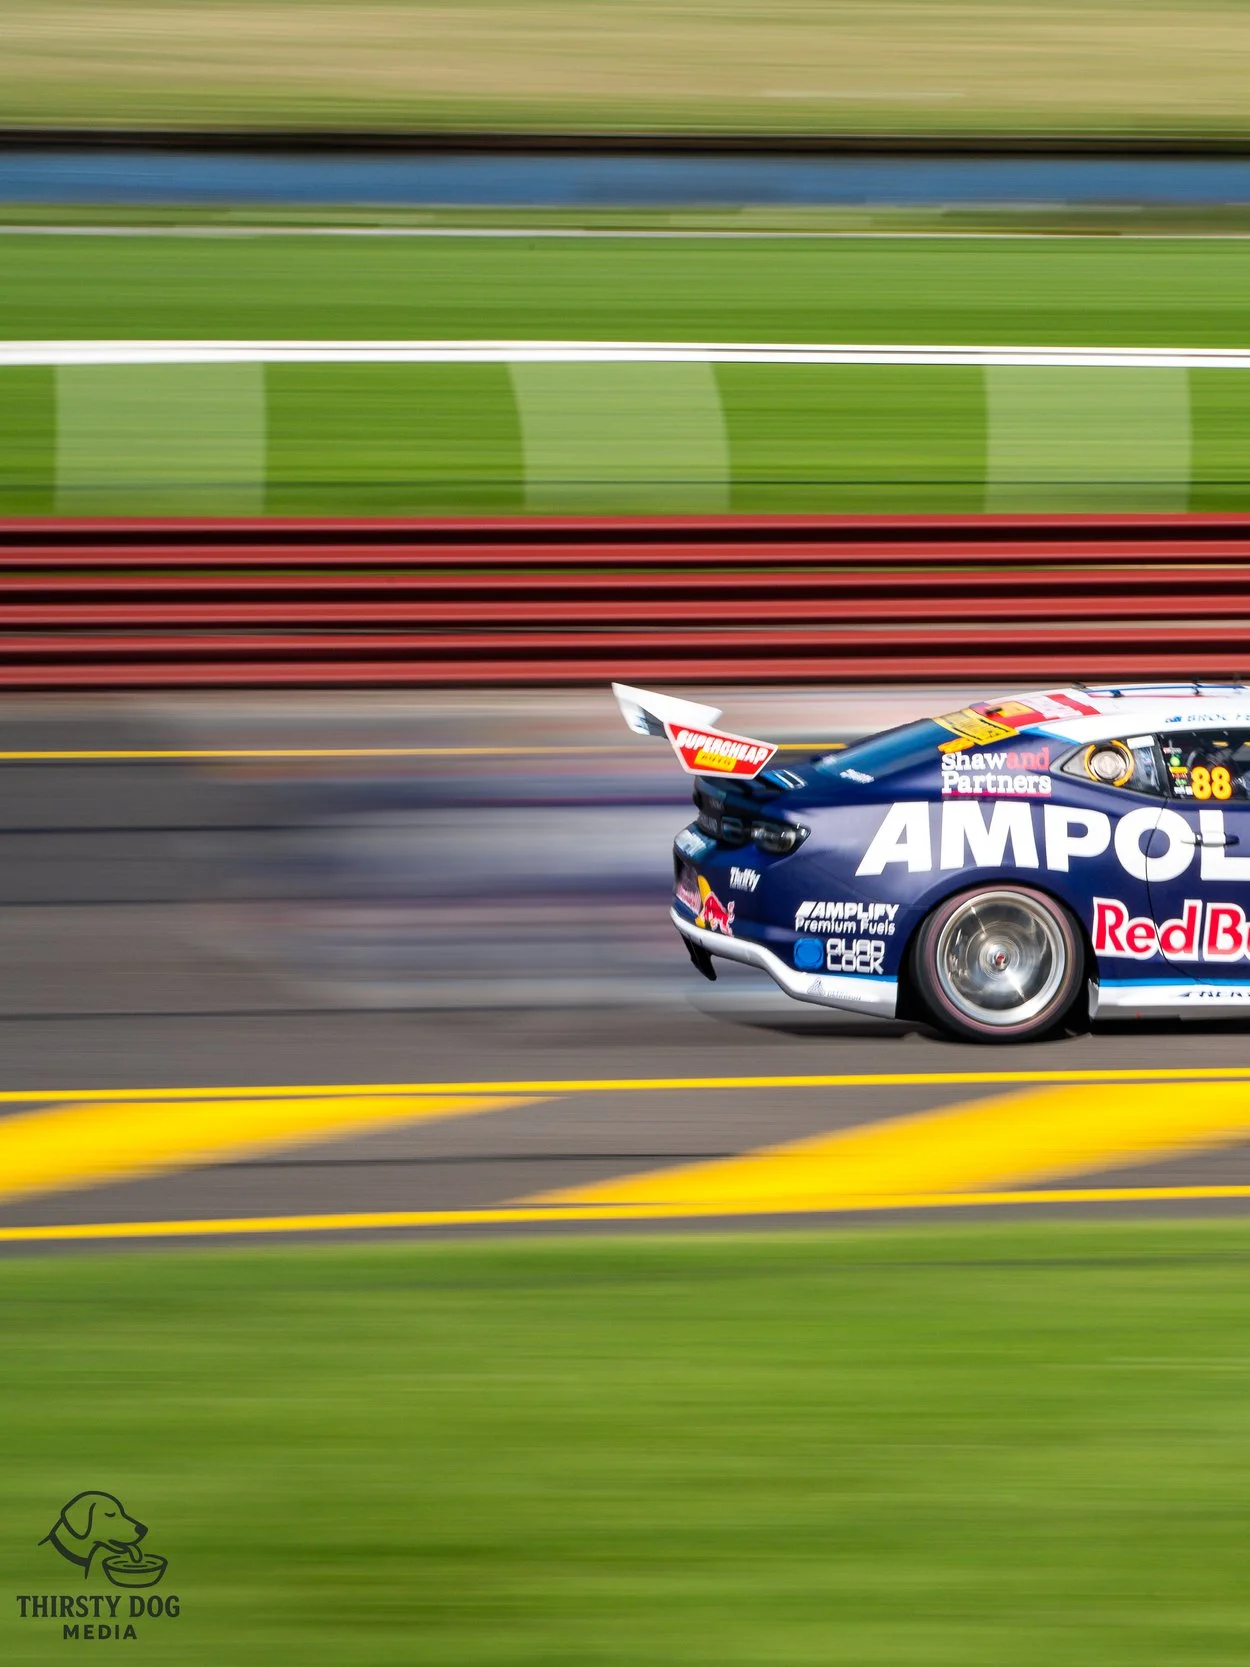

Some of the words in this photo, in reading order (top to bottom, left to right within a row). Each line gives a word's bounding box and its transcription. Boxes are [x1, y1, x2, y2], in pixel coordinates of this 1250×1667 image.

[941, 770, 1052, 795] Partners
[1191, 766, 1232, 800] 88
[810, 901, 900, 921] AMPLIFY
[795, 915, 856, 934] Premium
[860, 915, 896, 936] Fuels
[1093, 897, 1202, 961] Red
